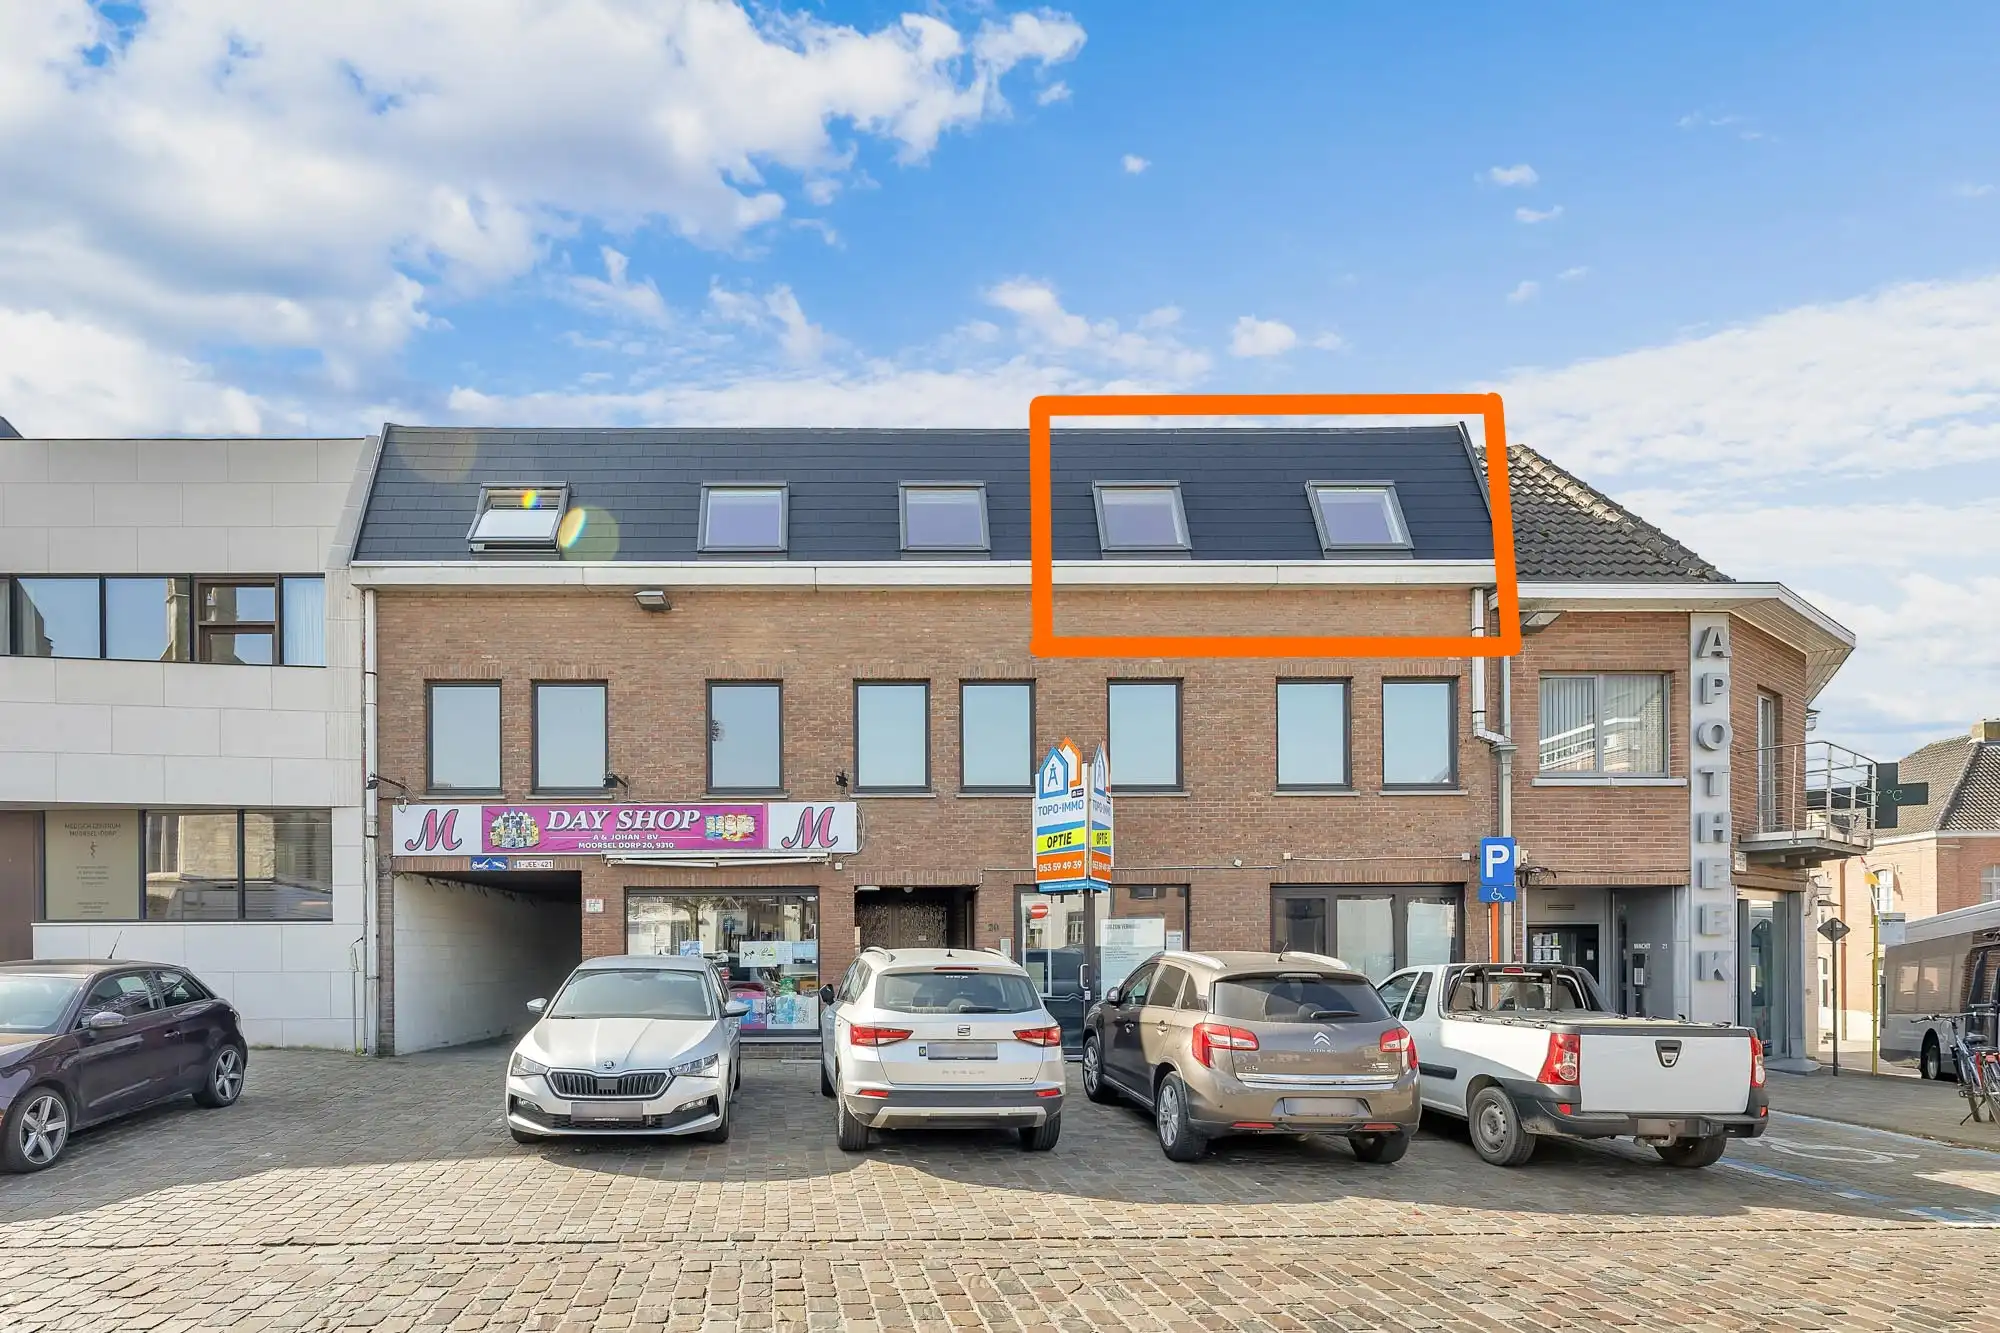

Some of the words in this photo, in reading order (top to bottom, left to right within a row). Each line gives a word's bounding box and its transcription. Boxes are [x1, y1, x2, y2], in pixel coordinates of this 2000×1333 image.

[1698, 626, 1733, 981] APOTHEEK
[405, 808, 463, 852] M
[546, 810, 611, 831] DAY
[616, 809, 701, 831] SHOP
[781, 806, 839, 849] M
[642, 842, 654, 850] 20,
[1046, 832, 1072, 849] OPTIE
[1039, 863, 1052, 872] 053
[1053, 862, 1061, 871] 59
[1062, 861, 1072, 870] 49
[1072, 860, 1082, 869] 39
[1486, 845, 1510, 878] P
